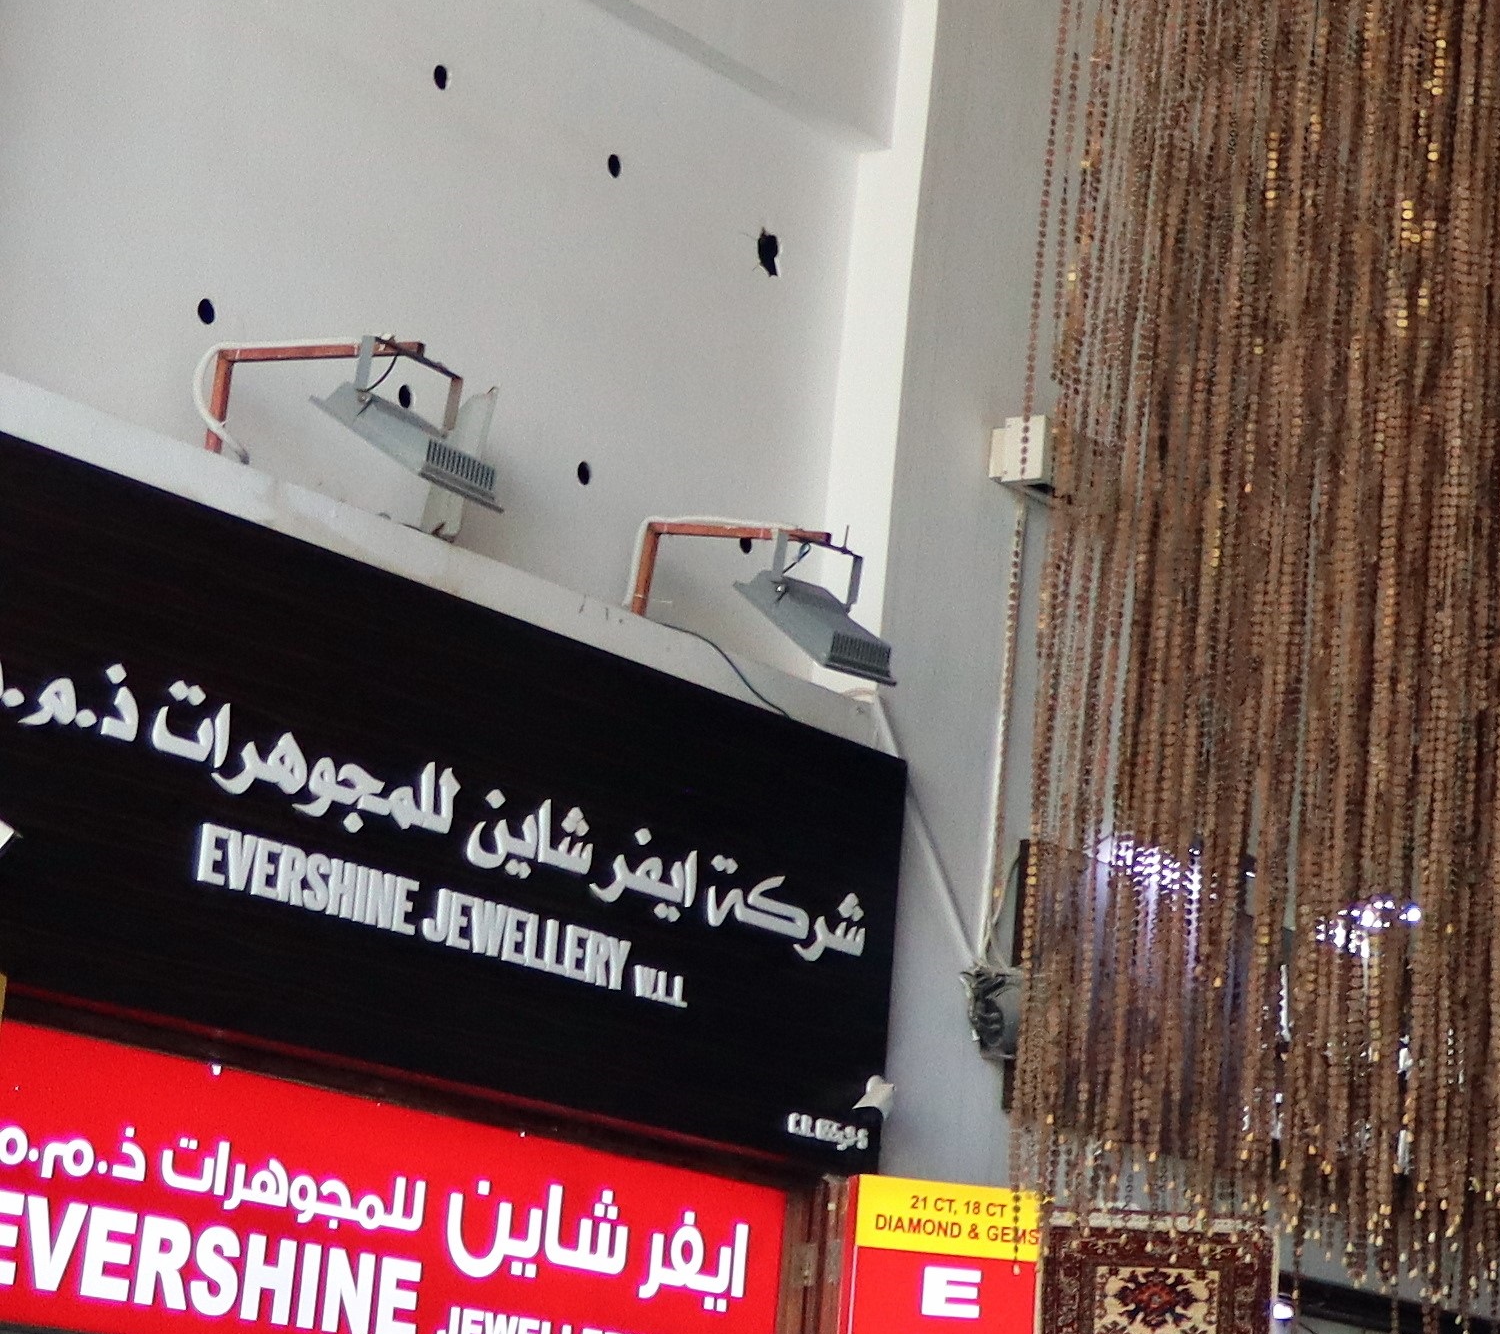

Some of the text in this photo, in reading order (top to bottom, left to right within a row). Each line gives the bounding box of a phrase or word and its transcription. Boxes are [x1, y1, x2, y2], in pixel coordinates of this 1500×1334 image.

[0, 661, 866, 961] شركة ايفر شاين للمجوهرات ذ.م.
[197, 824, 418, 937] EVERSHINE
[422, 887, 632, 991] JEWELLERY
[161, 1138, 428, 1233] للمجوهرات
[447, 1178, 629, 1280] شاين
[875, 1213, 1041, 1245] DIAMOND & GEMS
[910, 1195, 1007, 1218] 21 CT, 18 CT
[639, 1210, 749, 1313] ايفر
